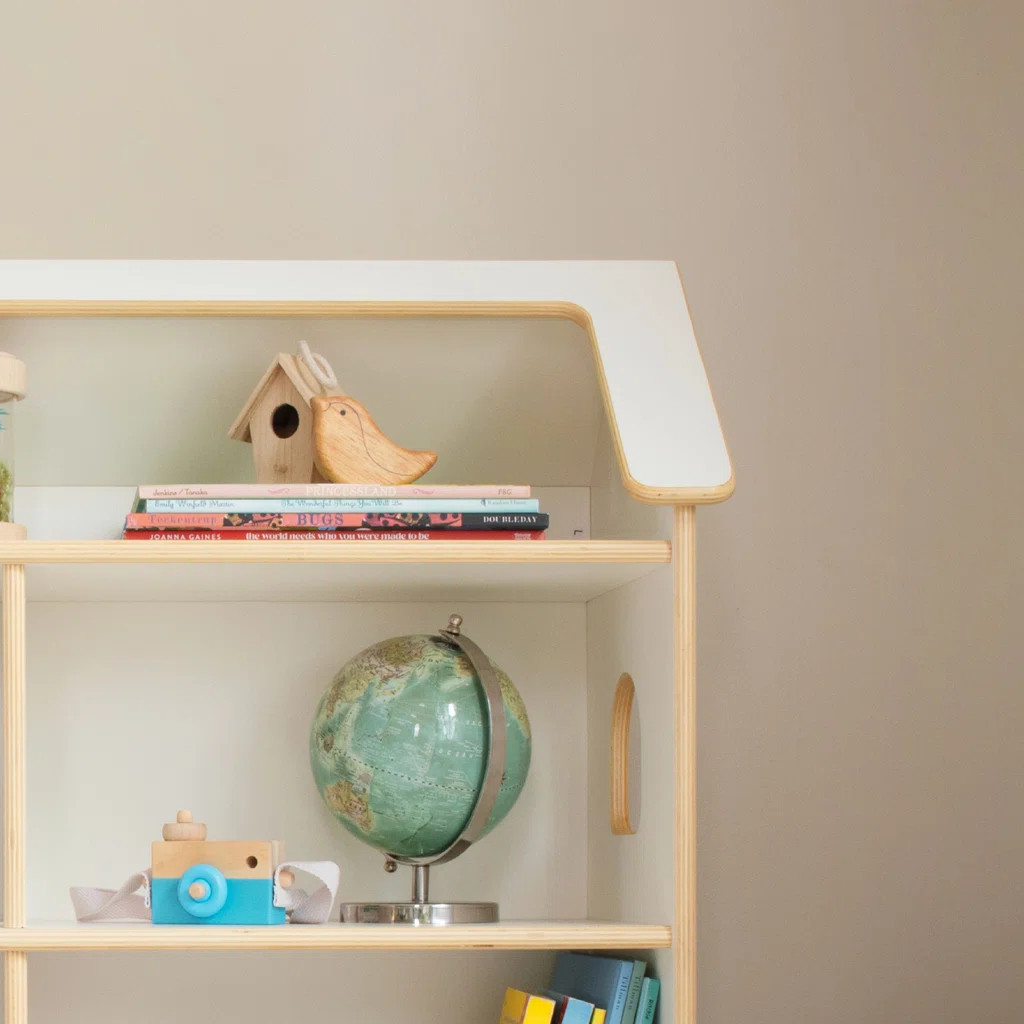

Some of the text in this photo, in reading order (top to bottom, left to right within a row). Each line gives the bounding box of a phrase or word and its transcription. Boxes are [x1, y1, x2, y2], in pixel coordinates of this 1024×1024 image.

[185, 488, 208, 496] Tanaka
[306, 485, 397, 496] PRINCESSLAND
[334, 499, 357, 508] Things
[358, 499, 372, 508] You
[297, 513, 344, 525] BUGS
[483, 516, 538, 524] DOUBLEDAY
[150, 533, 221, 541] JOANNA GAINES
[246, 532, 429, 541] the world needs who you were made to be
[616, 976, 628, 1009] Tillman
[628, 975, 641, 1009] Tillman
